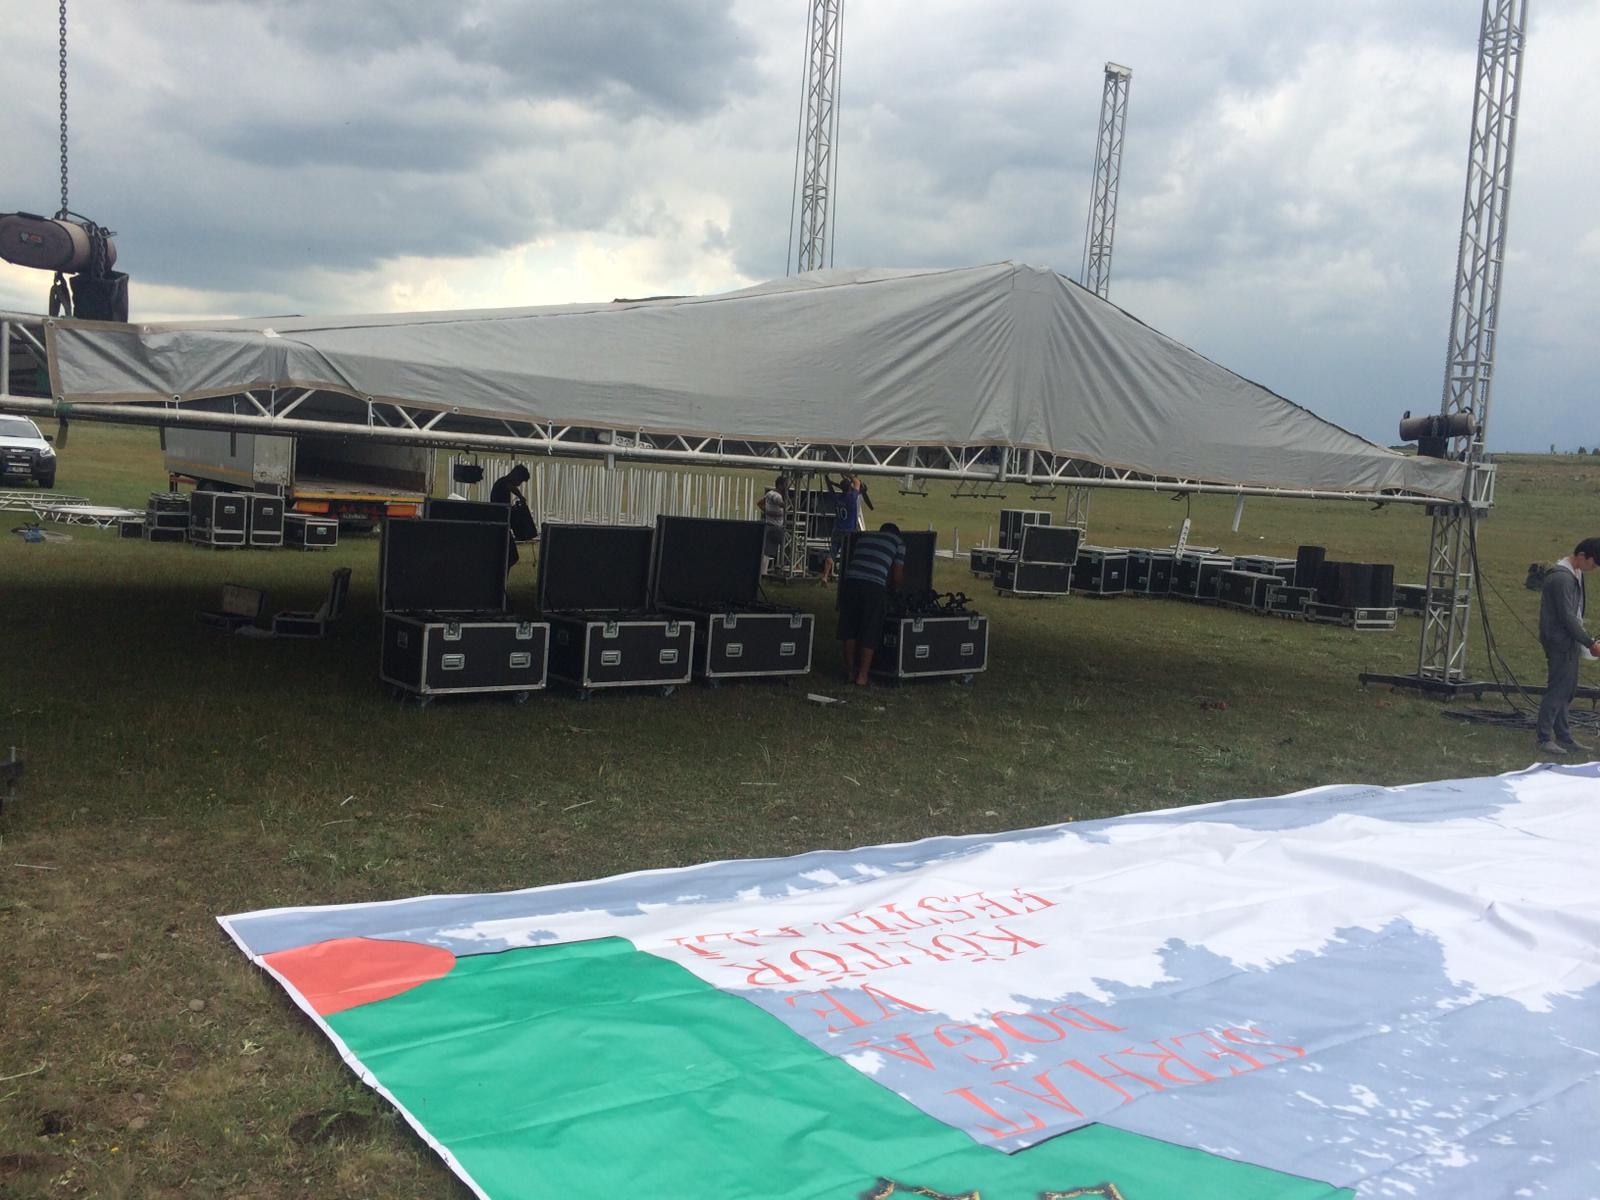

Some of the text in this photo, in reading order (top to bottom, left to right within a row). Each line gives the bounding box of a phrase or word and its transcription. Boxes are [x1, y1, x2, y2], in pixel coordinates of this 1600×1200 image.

[719, 924, 1046, 987] KÜLTÜR
[785, 982, 935, 1034] VE
[849, 1005, 1128, 1073] DOĞA
[945, 1027, 1306, 1139] SERHAT
